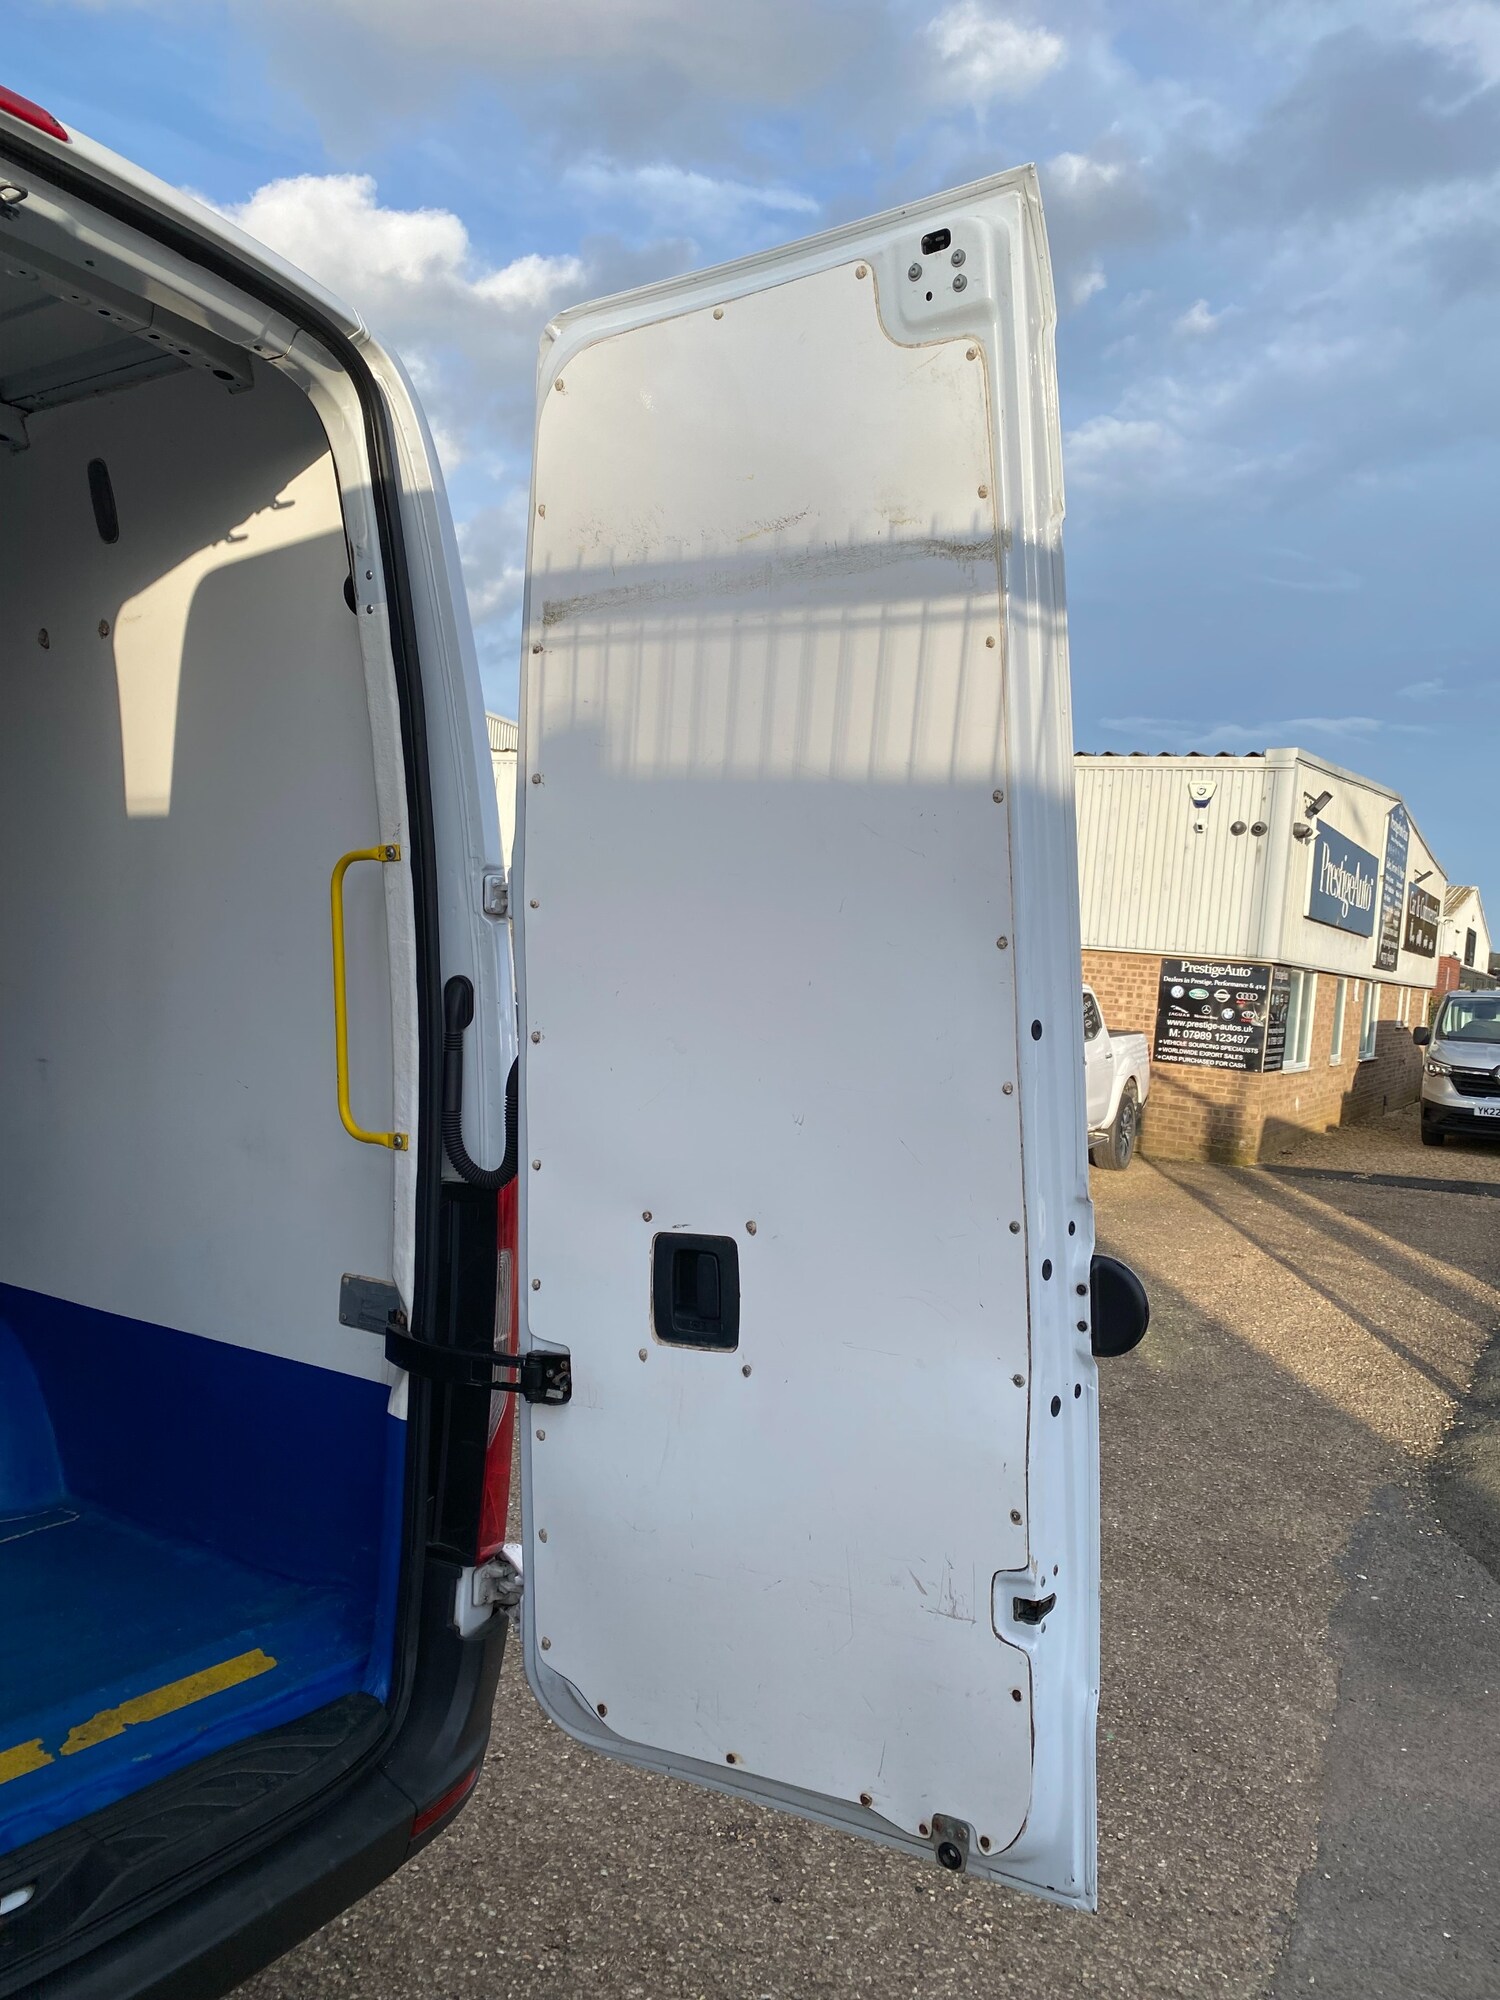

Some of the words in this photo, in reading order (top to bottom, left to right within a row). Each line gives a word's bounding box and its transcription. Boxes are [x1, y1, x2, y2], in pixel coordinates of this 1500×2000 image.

[1320, 841, 1373, 918] PrestigeAuto
[1180, 961, 1252, 978] PrestigeAuto
[1190, 978, 1213, 986] Prestige,
[1214, 980, 1248, 988] Performance
[1167, 1020, 1254, 1033] www.prestige-autos.uk
[1168, 1028, 1180, 1038] M:
[1214, 1033, 1250, 1044] 123497
[1162, 1047, 1198, 1056] WORLDWIDE
[1199, 1050, 1223, 1058] EXPORT
[1188, 1042, 1219, 1050] SOURCING
[1220, 1044, 1259, 1054] SPECIALISTS
[1178, 1056, 1214, 1066] PURCHASED
